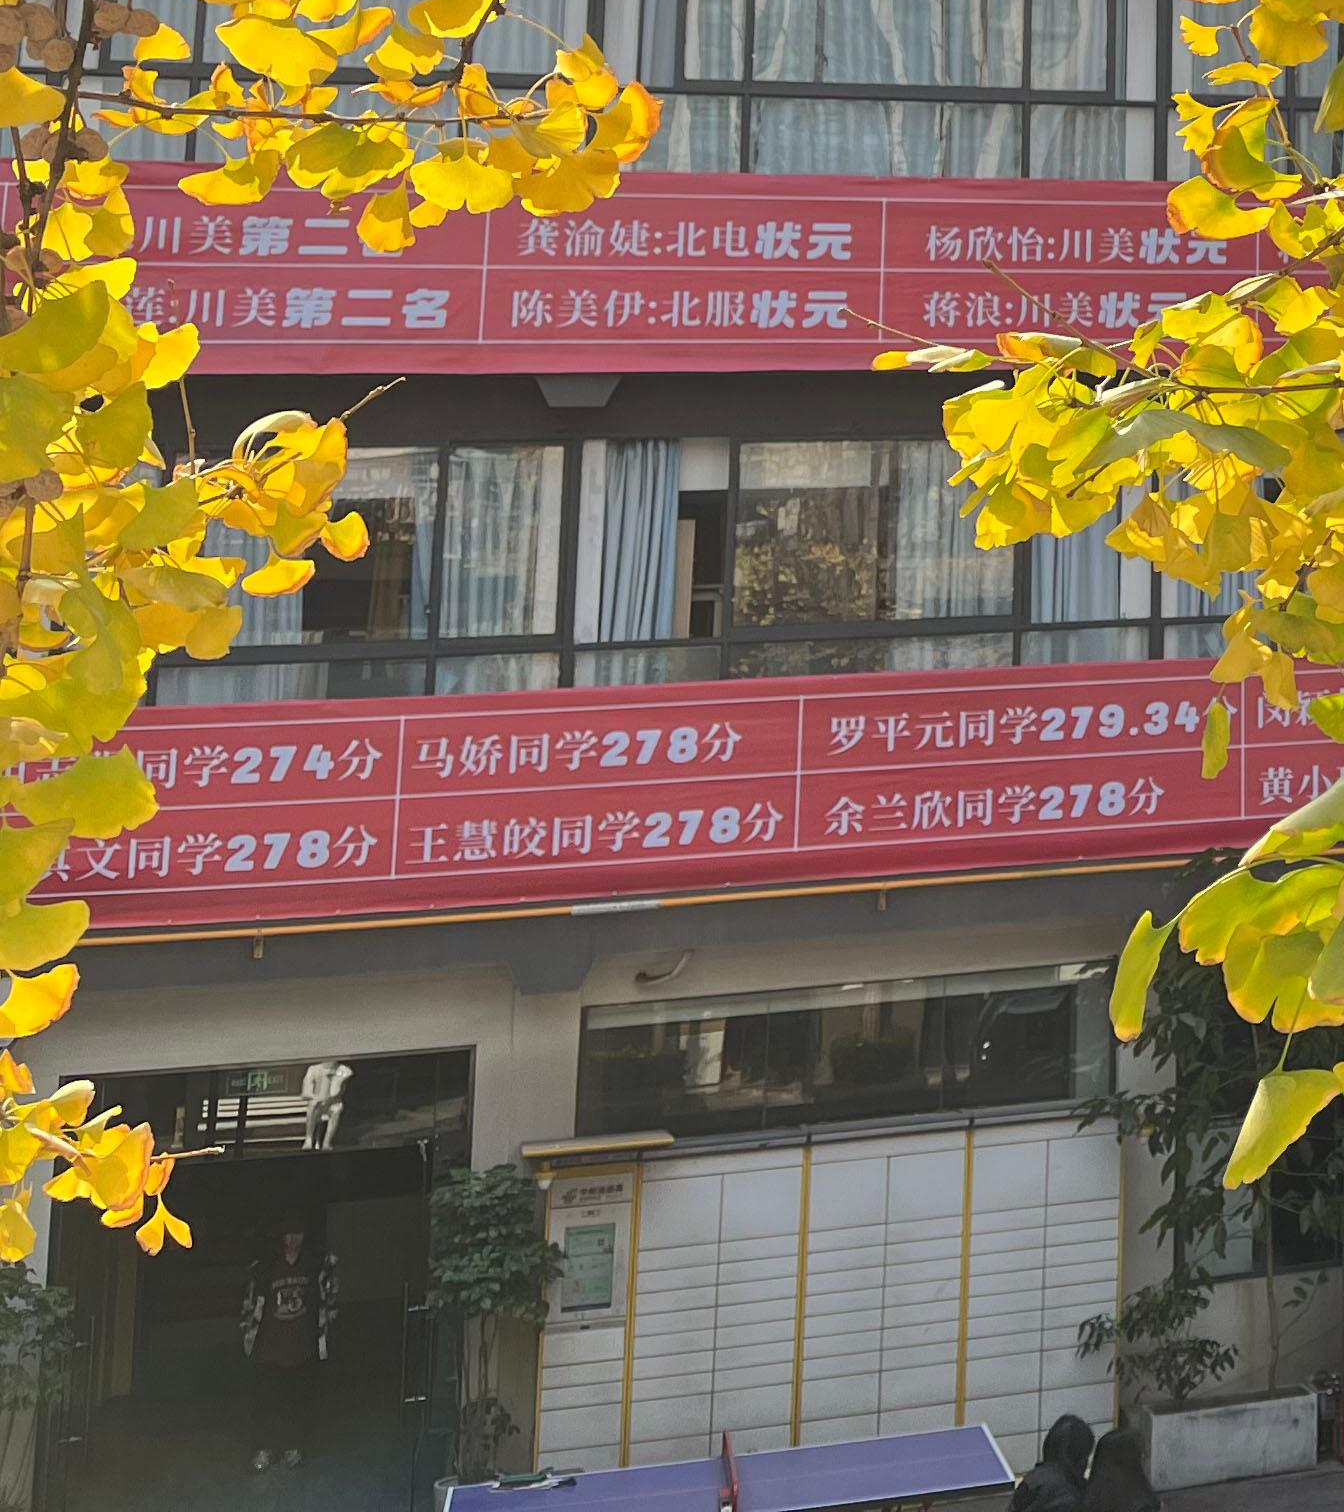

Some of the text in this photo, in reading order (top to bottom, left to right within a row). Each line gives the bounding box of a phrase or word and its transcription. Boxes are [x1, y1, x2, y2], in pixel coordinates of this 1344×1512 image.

[410, 721, 742, 779] 马娇同学278分
[823, 775, 1166, 837] 余兰欣同学278分
